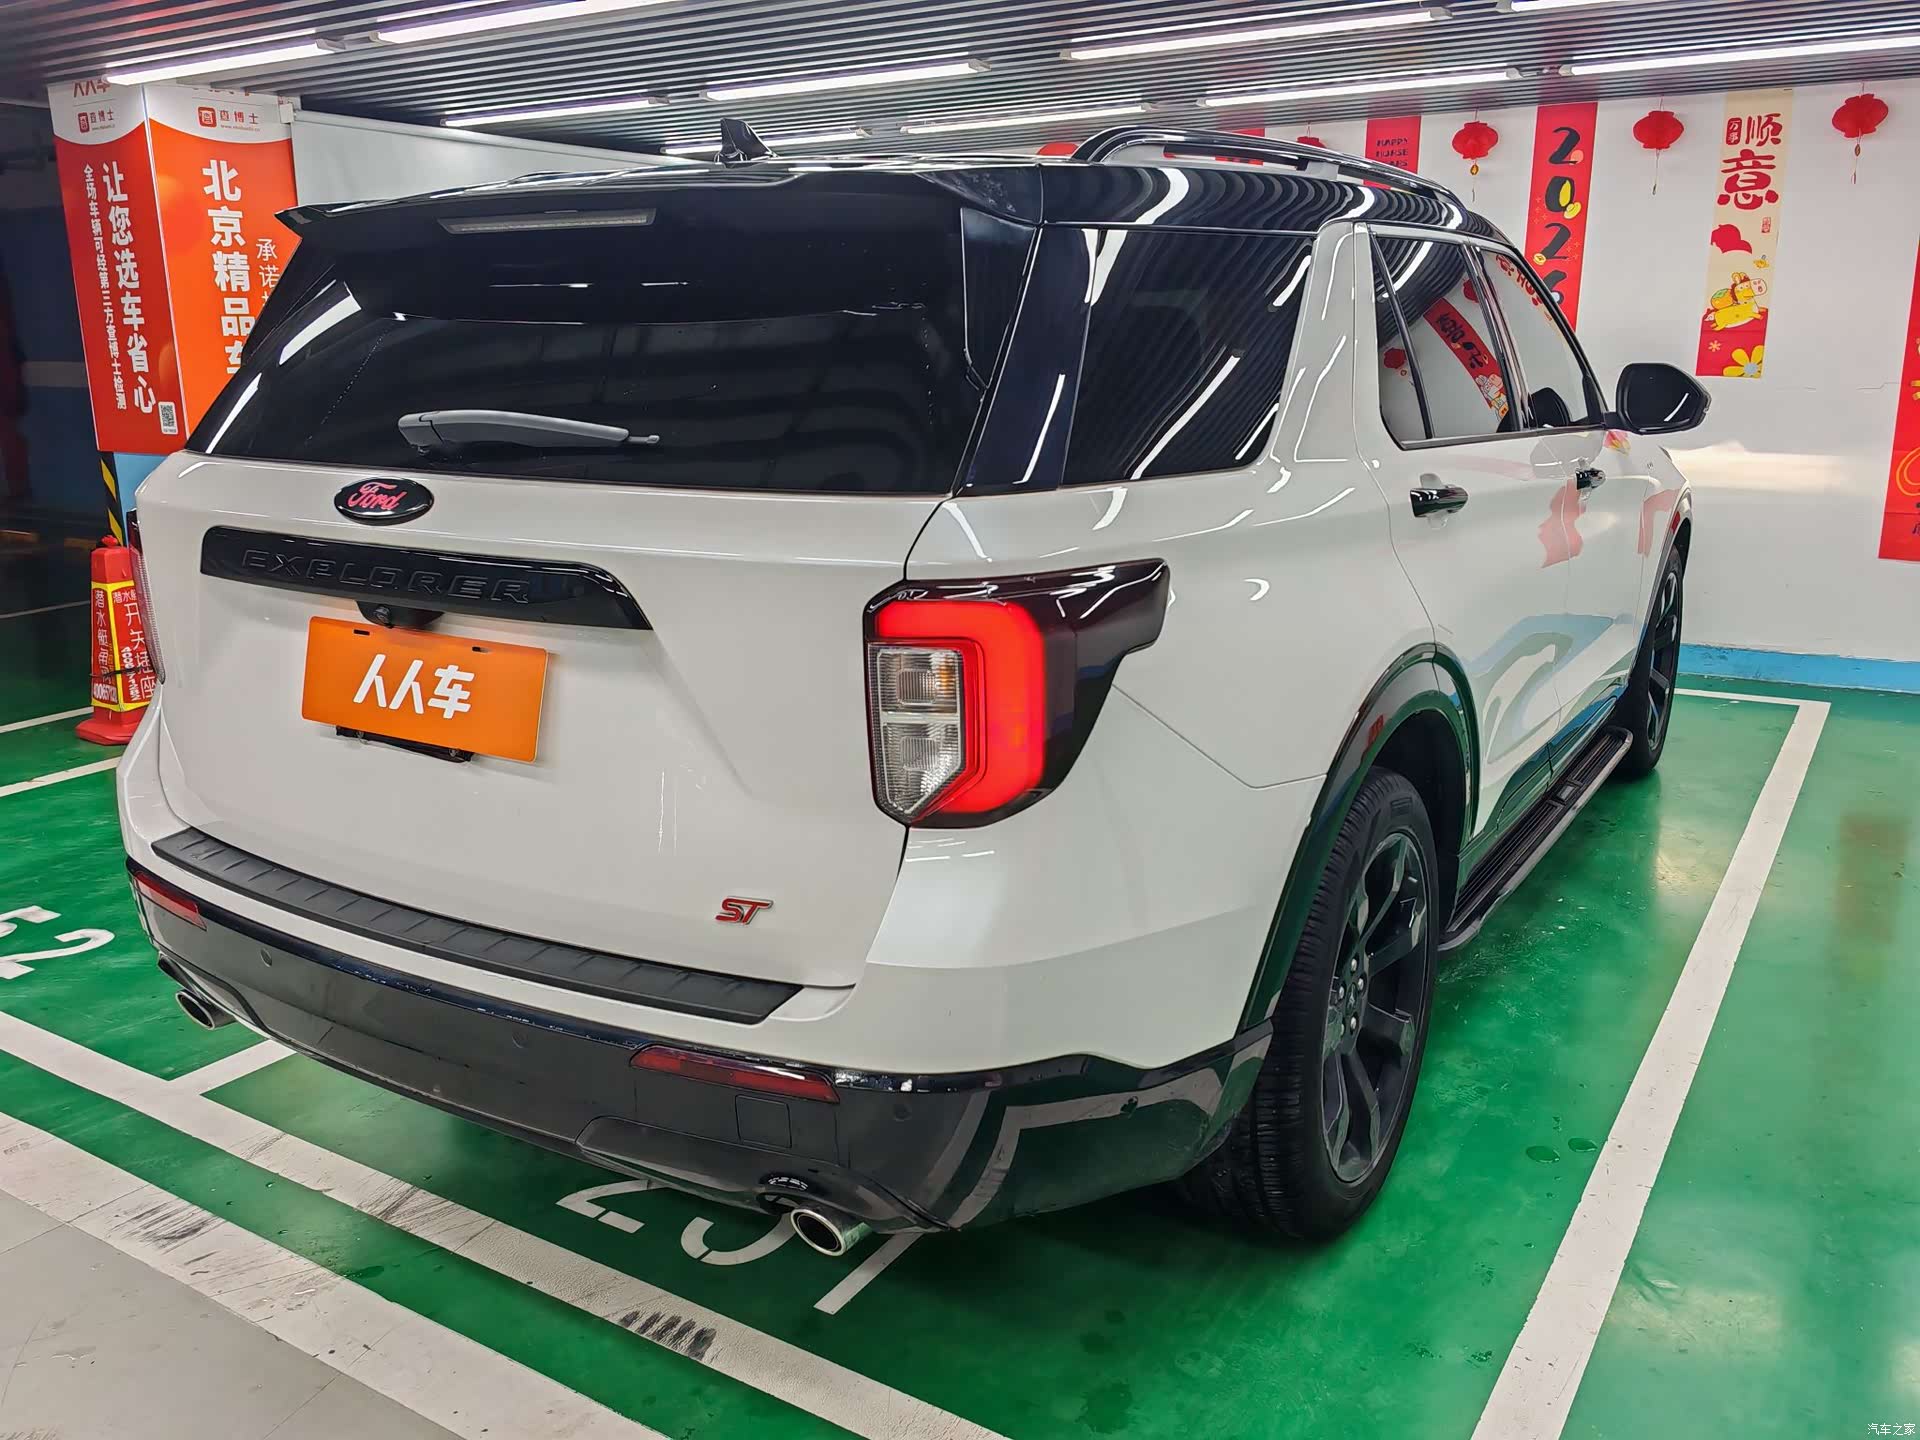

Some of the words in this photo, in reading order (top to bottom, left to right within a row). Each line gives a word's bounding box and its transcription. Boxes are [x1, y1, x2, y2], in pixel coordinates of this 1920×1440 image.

[102, 160, 156, 414] 让您选车省心
[347, 481, 408, 511] Ford
[241, 549, 530, 604] EXPLORER
[352, 653, 475, 719] 人人车
[715, 896, 774, 926] ST
